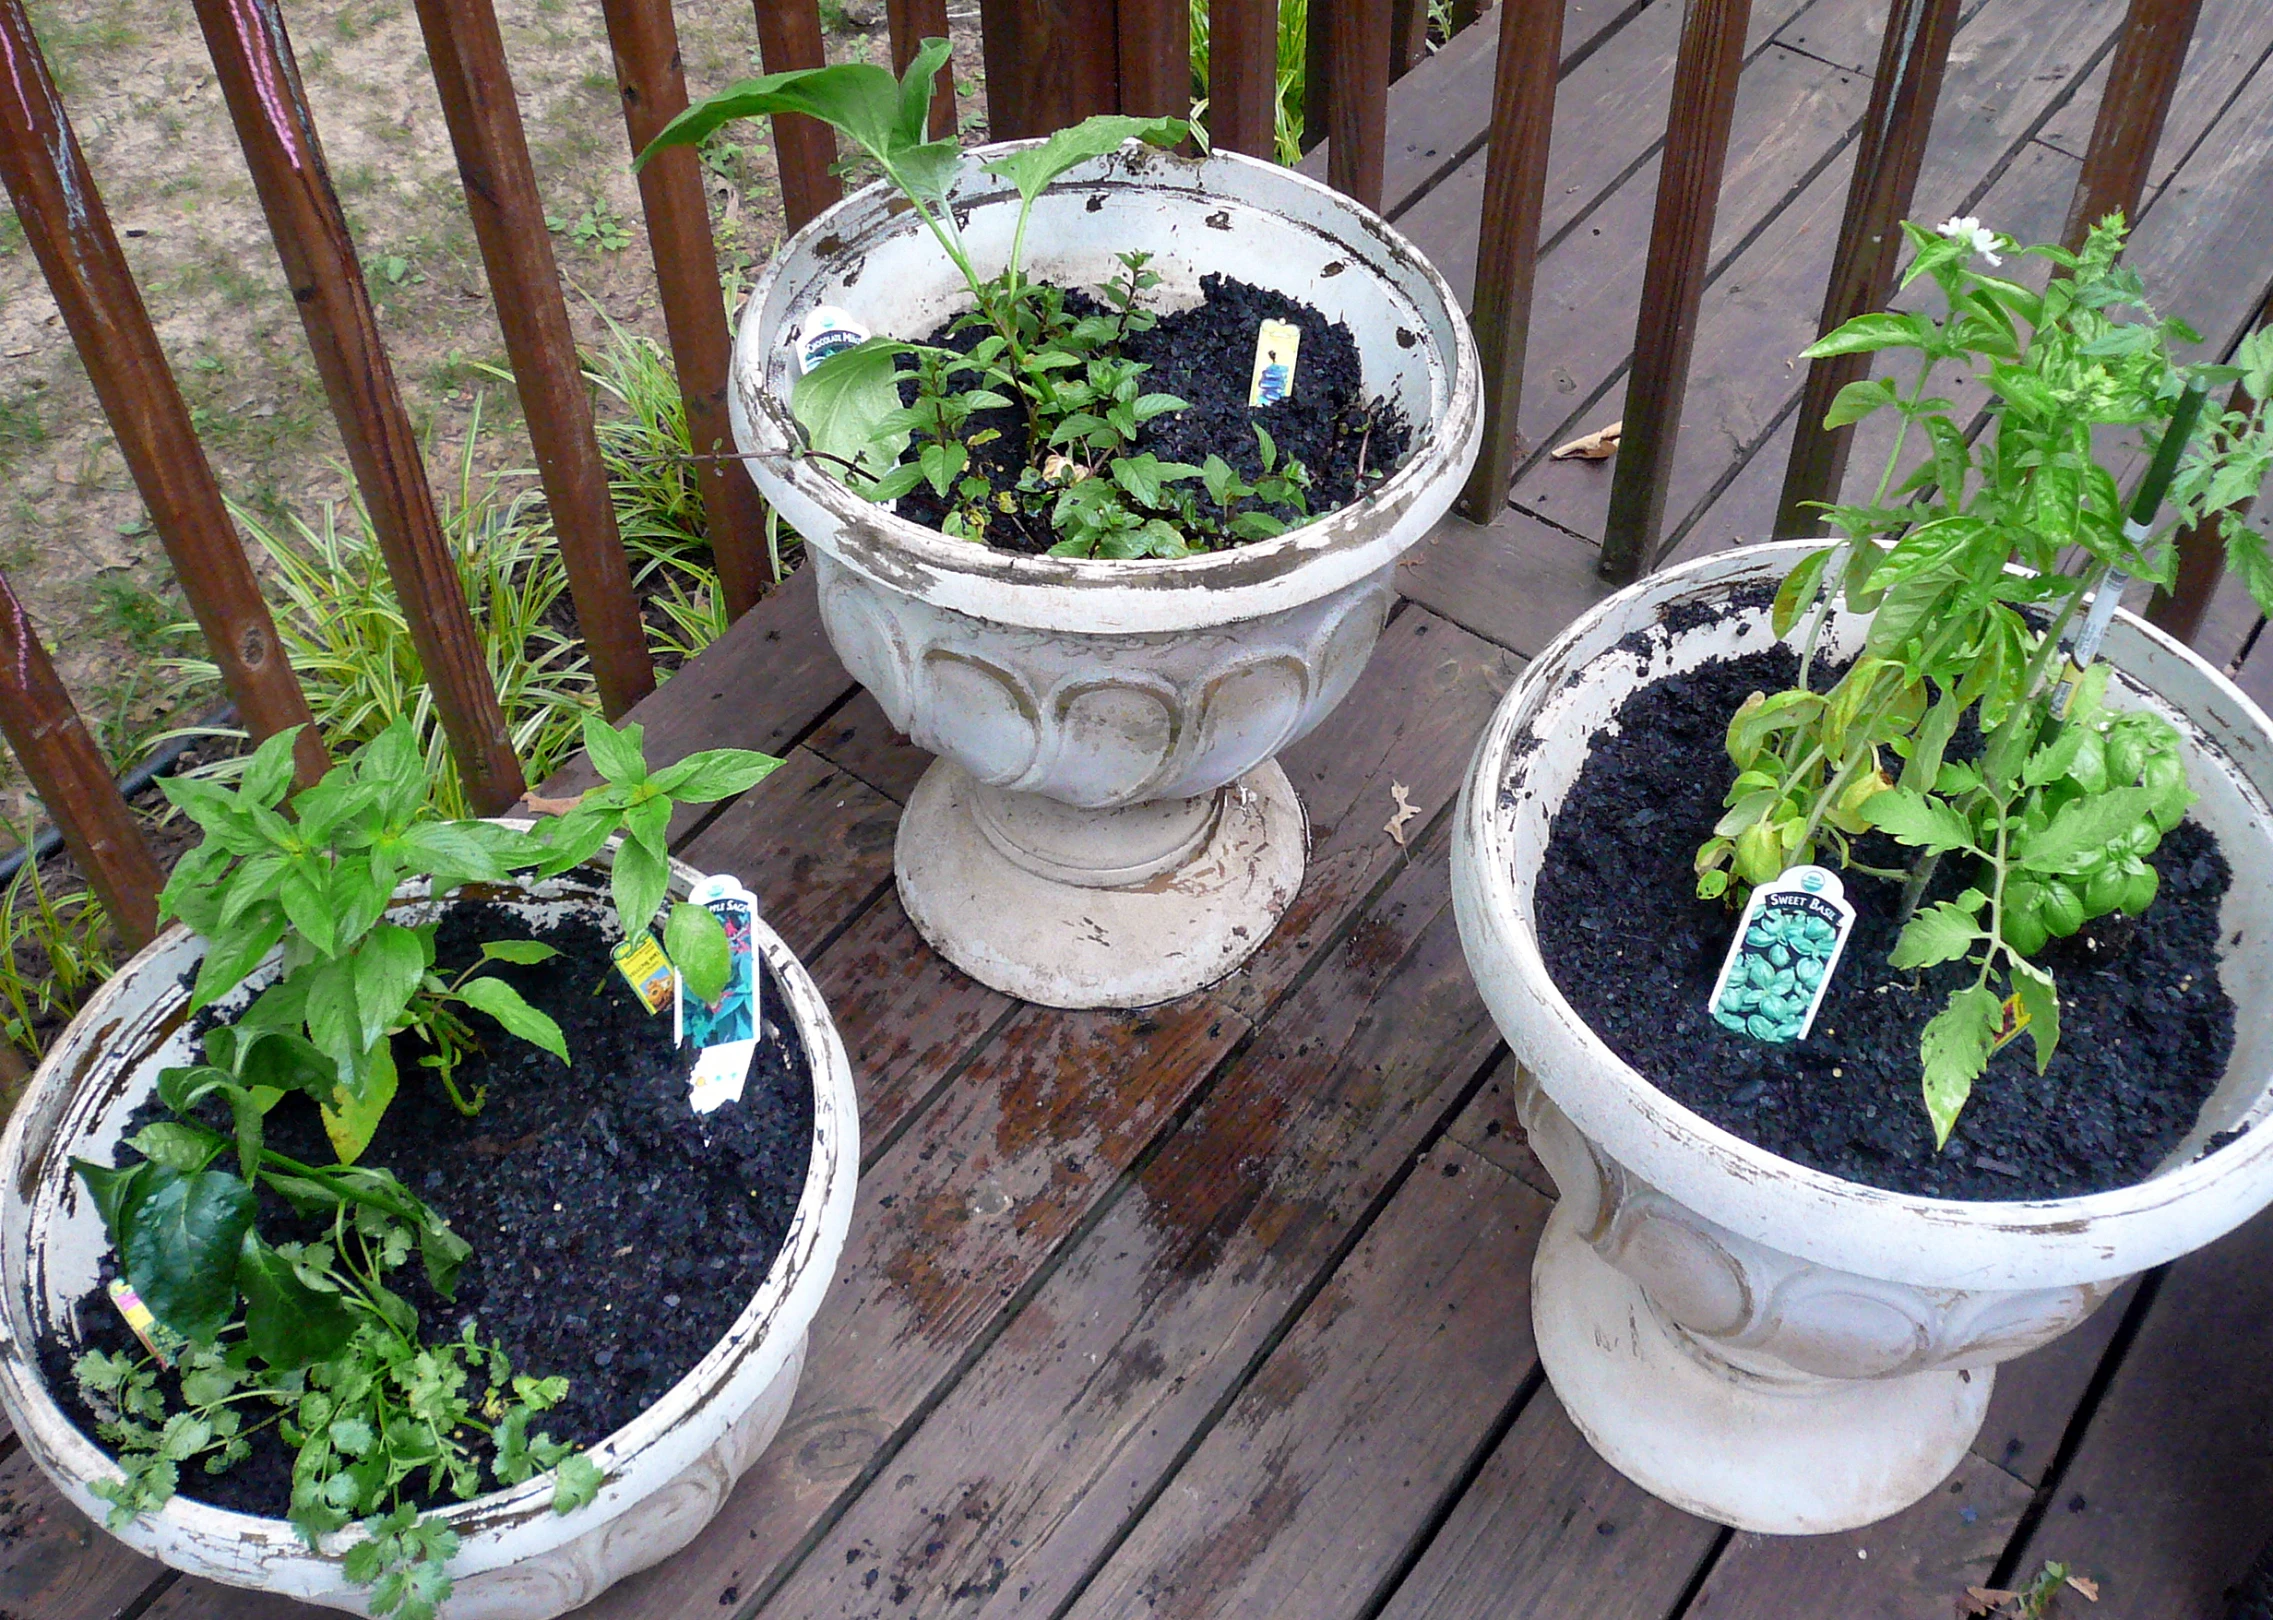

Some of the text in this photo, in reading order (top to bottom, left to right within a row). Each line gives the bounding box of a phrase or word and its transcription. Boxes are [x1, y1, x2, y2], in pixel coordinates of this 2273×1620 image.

[807, 334, 842, 353] CHOCOLATE
[1770, 893, 1837, 921] SWEET BASIL
